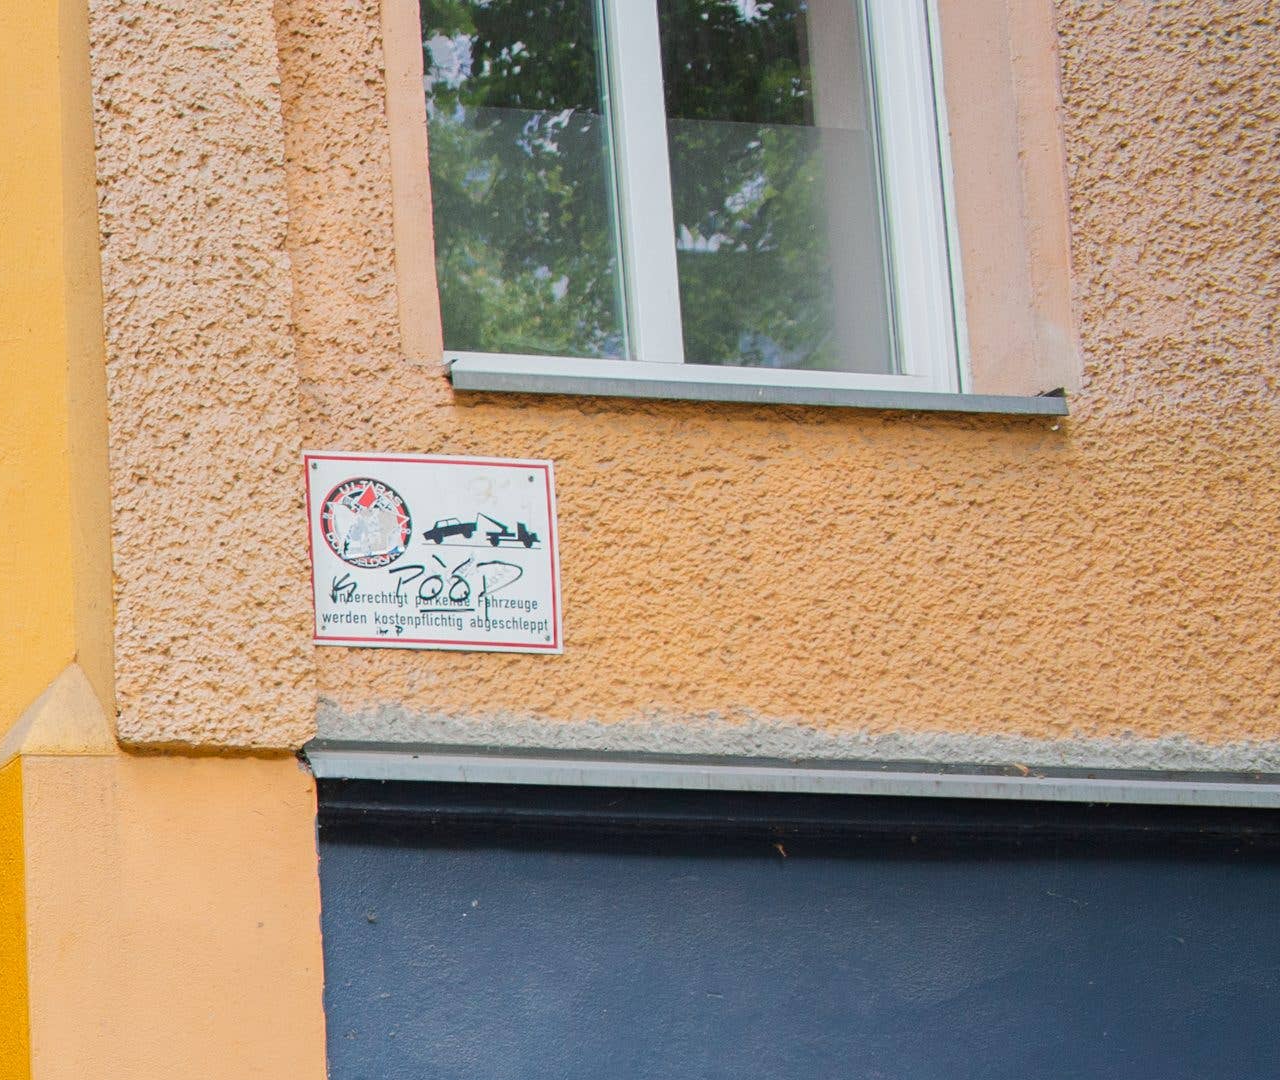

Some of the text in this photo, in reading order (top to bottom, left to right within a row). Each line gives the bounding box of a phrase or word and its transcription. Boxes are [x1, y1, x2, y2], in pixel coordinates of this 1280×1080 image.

[478, 596, 538, 613] Fahrzeuge
[322, 611, 548, 634] werden kostenpflichtig abgeschleppt
